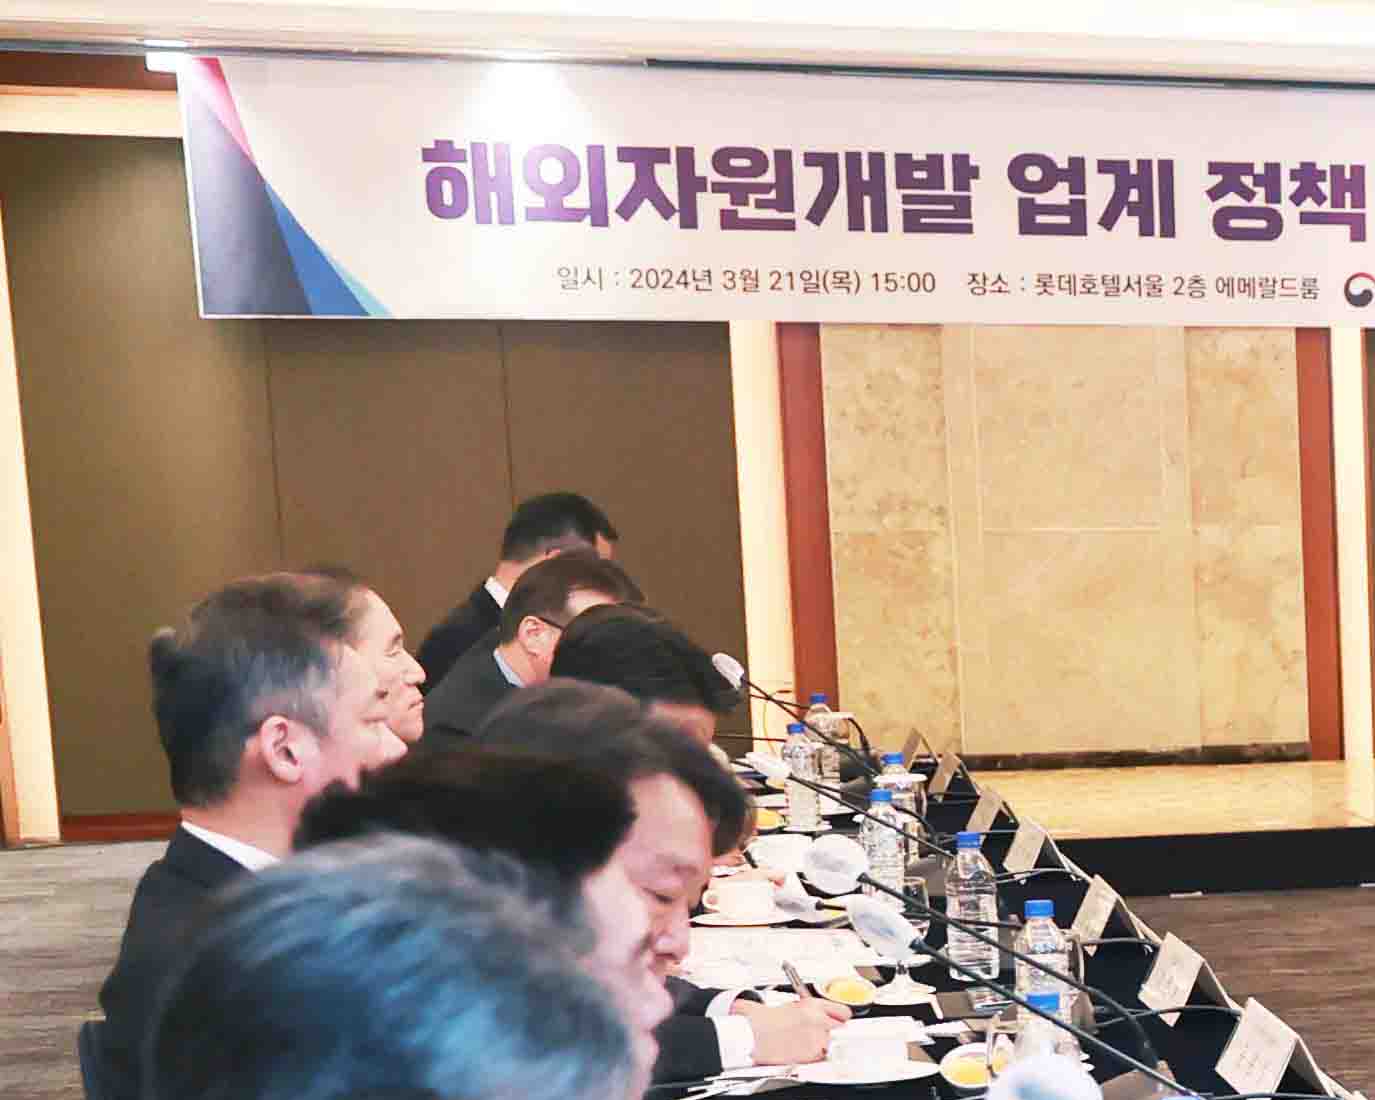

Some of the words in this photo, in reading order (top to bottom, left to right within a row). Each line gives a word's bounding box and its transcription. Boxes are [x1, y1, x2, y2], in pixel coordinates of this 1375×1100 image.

[421, 140, 979, 234] 해외자원개발
[1006, 152, 1176, 240] 업계
[1204, 160, 1367, 243] 정책
[556, 265, 604, 292] 일시
[628, 267, 713, 293] 2024년
[720, 267, 761, 294] 3월
[767, 268, 861, 295] 21일(목)
[870, 270, 937, 294] 15:00
[967, 272, 1012, 296] 장소
[1034, 272, 1165, 298] 롯데호텔서울
[1172, 274, 1207, 299] 2층
[1215, 275, 1321, 301] 에메랄드룸
